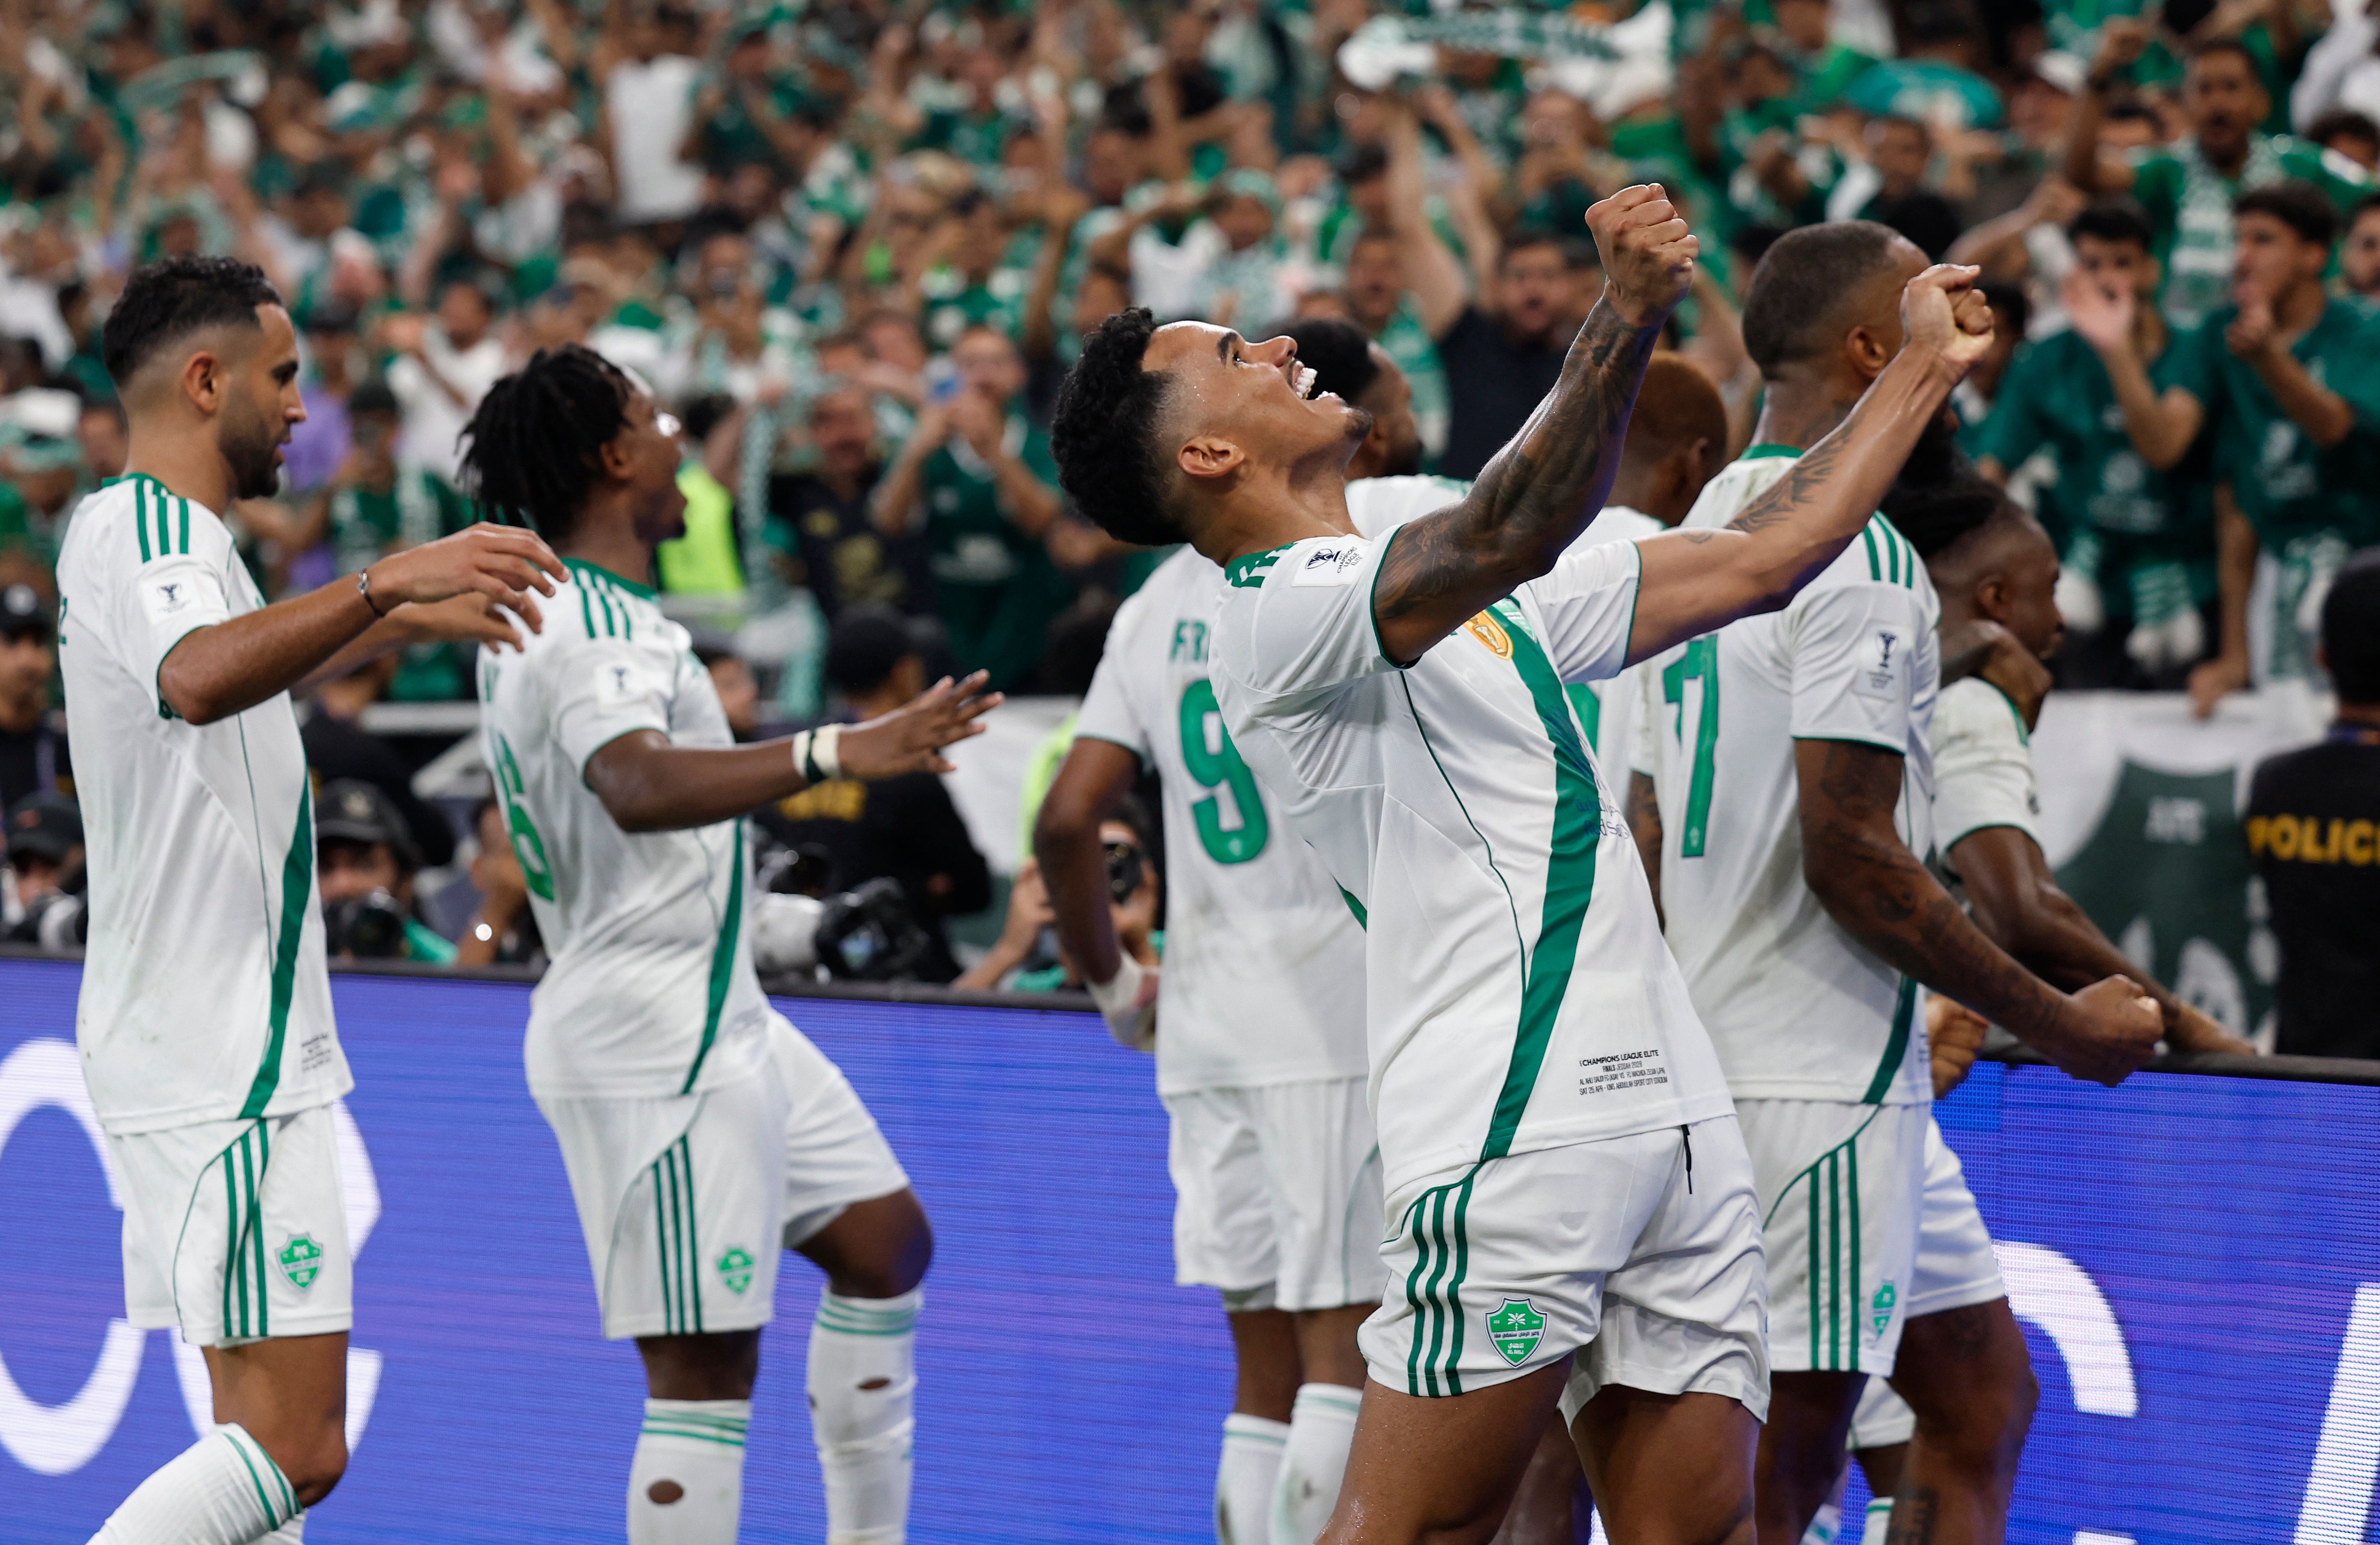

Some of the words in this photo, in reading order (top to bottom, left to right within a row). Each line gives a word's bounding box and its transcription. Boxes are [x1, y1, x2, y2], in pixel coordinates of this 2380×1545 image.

[1337, 546, 1357, 574] CHAMPIONS
[1343, 552, 1359, 567] LEAGUE
[1350, 556, 1363, 566] ELITE
[1181, 679, 1268, 864] 9
[2248, 814, 2380, 865] POLIC
[1582, 1055, 1620, 1066] CHAMPIONS
[1620, 1052, 1643, 1061] LEAGUE
[1644, 1050, 1659, 1058] ELITE
[1603, 1064, 1615, 1072] FINALS
[1579, 1087, 1587, 1095] SAT
[1595, 1085, 1604, 1093] APR
